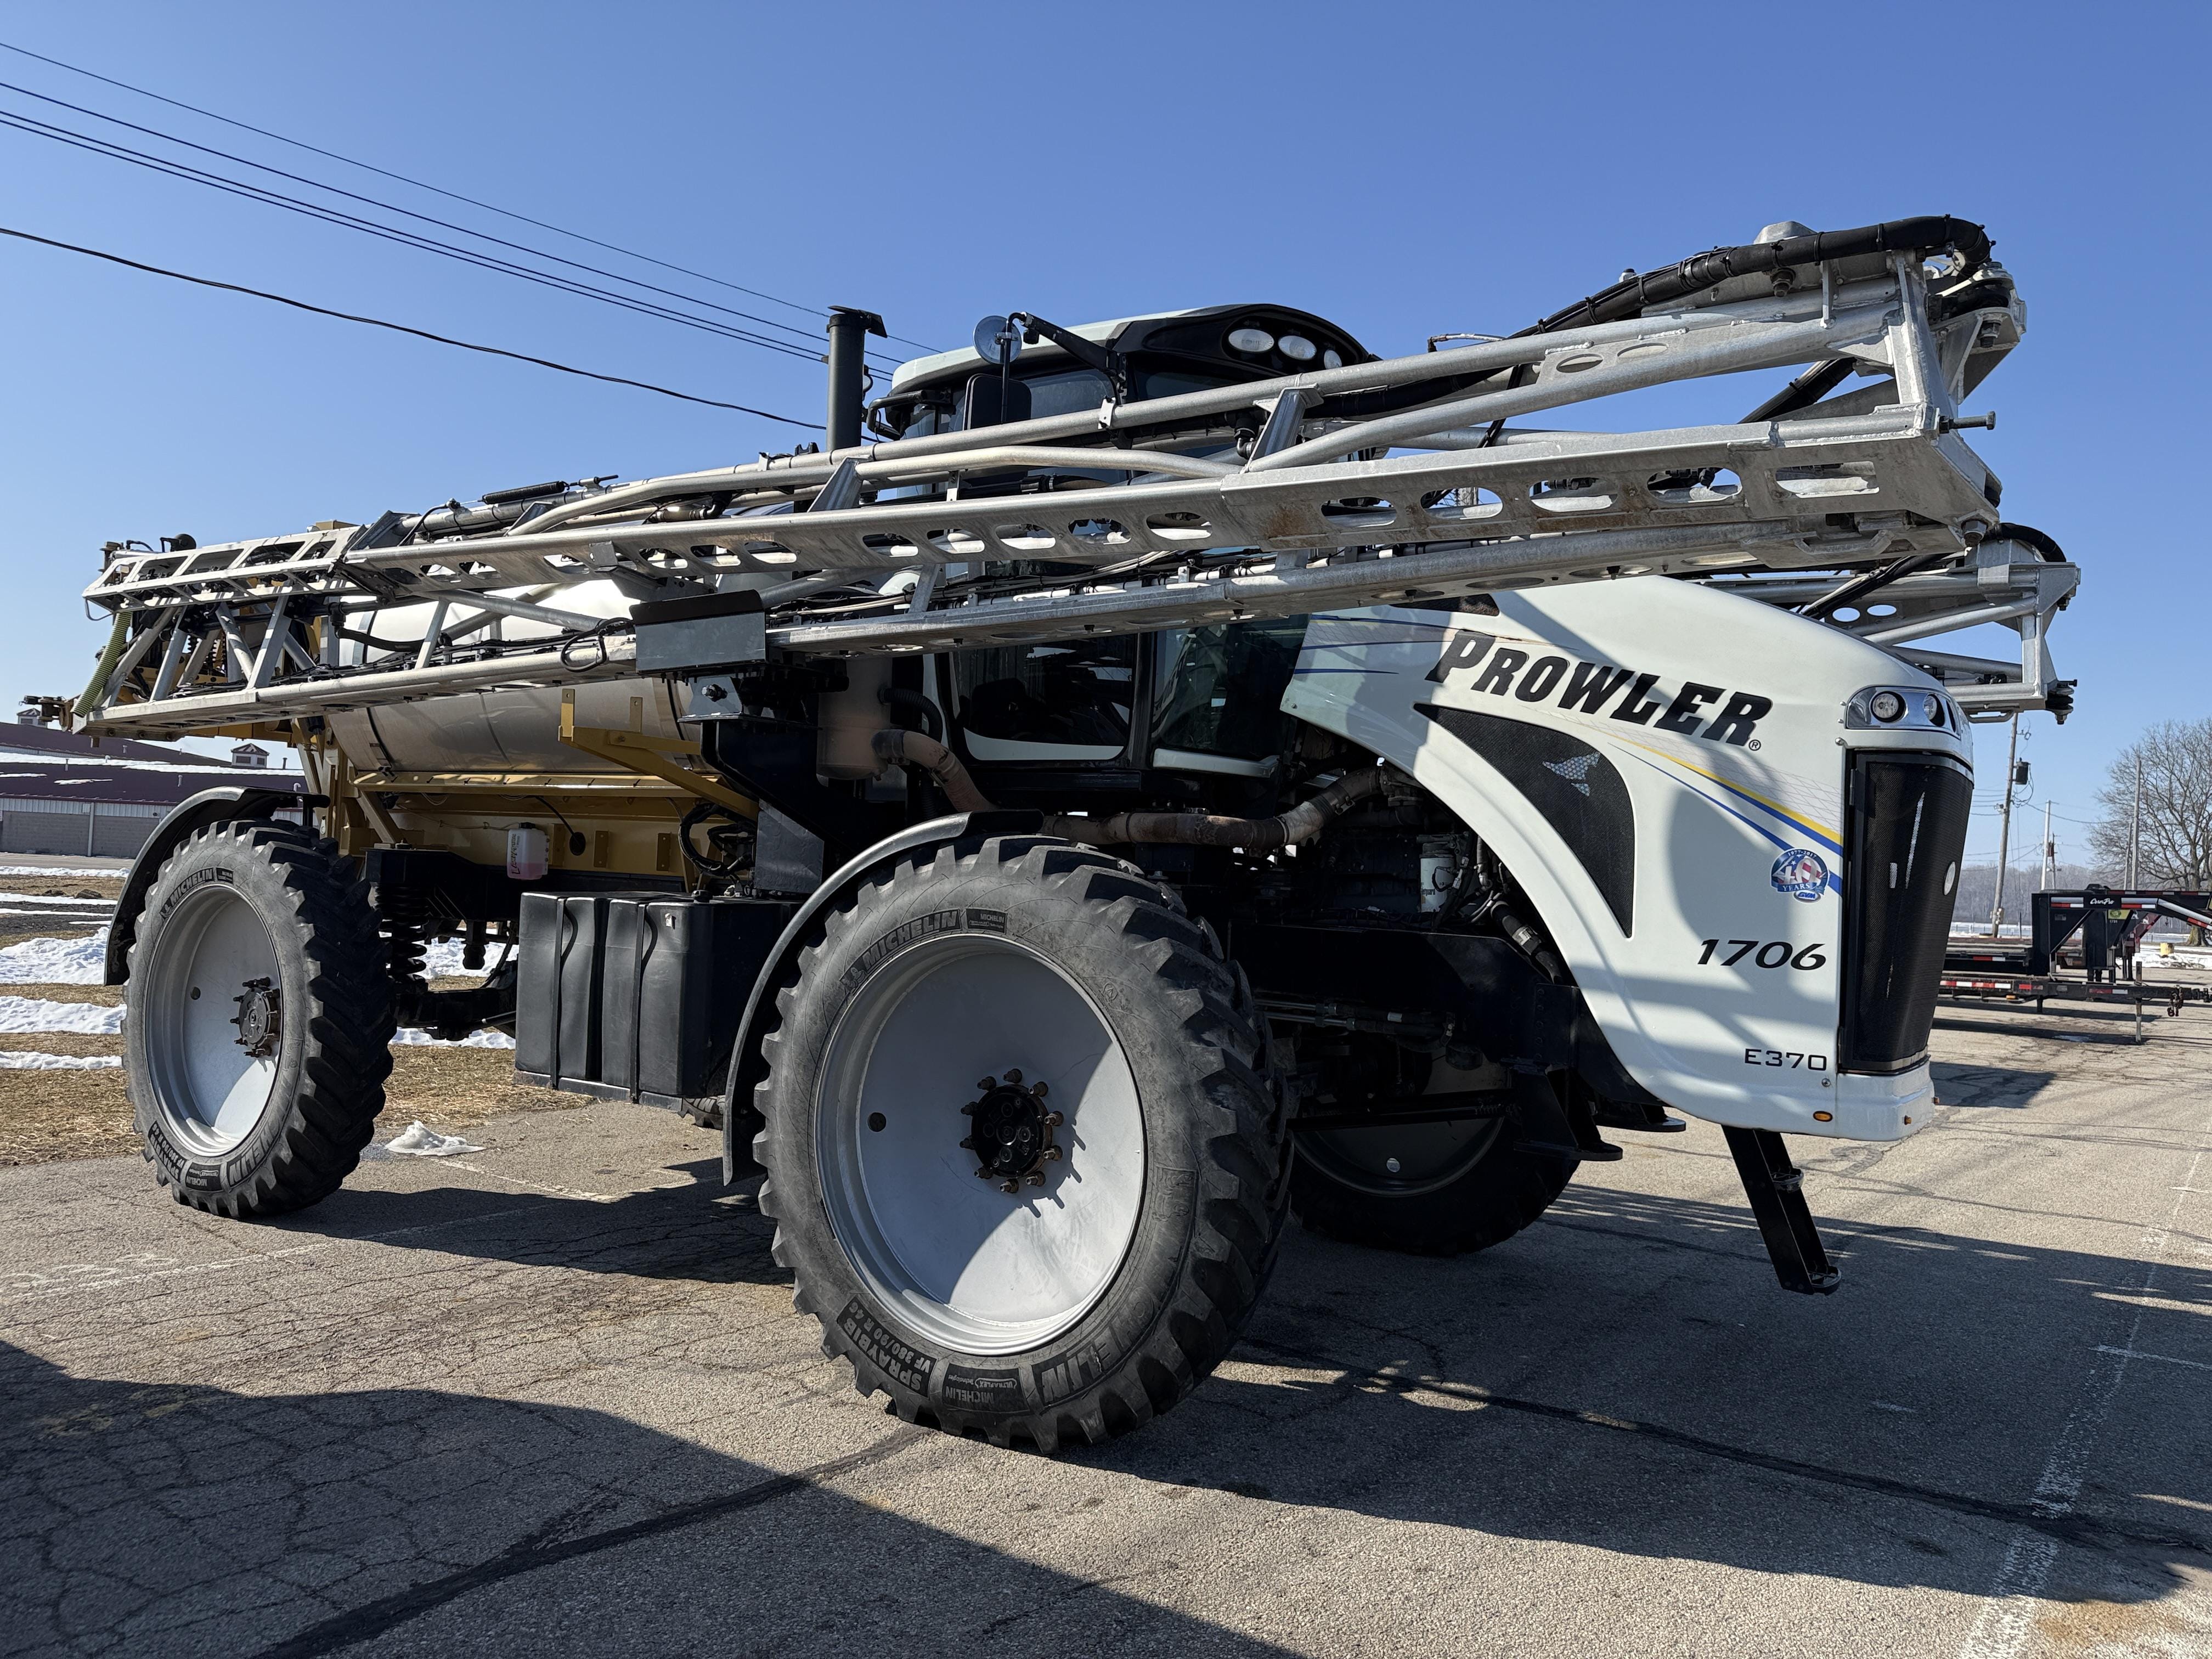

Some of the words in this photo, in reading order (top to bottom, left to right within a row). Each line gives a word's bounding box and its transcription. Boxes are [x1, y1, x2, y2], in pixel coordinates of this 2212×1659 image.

[1424, 628, 1773, 747] PROWLER
[170, 868, 212, 904] MICHELIN
[1782, 883, 1810, 891] YEARS
[980, 913, 1005, 923] MICHELIN
[862, 911, 957, 970] MICHELIN
[1697, 939, 1826, 970] 1706
[1745, 1048, 1827, 1071] E370
[849, 1301, 865, 1319] 46
[864, 1319, 875, 1331] R
[844, 1317, 922, 1391] SPRAYBIB
[874, 1327, 915, 1364] 380/90
[913, 1357, 932, 1373] VF
[948, 1374, 974, 1385] Technologies
[979, 1379, 1014, 1389] ULTRAFLEX
[945, 1386, 994, 1404] MICHELIN
